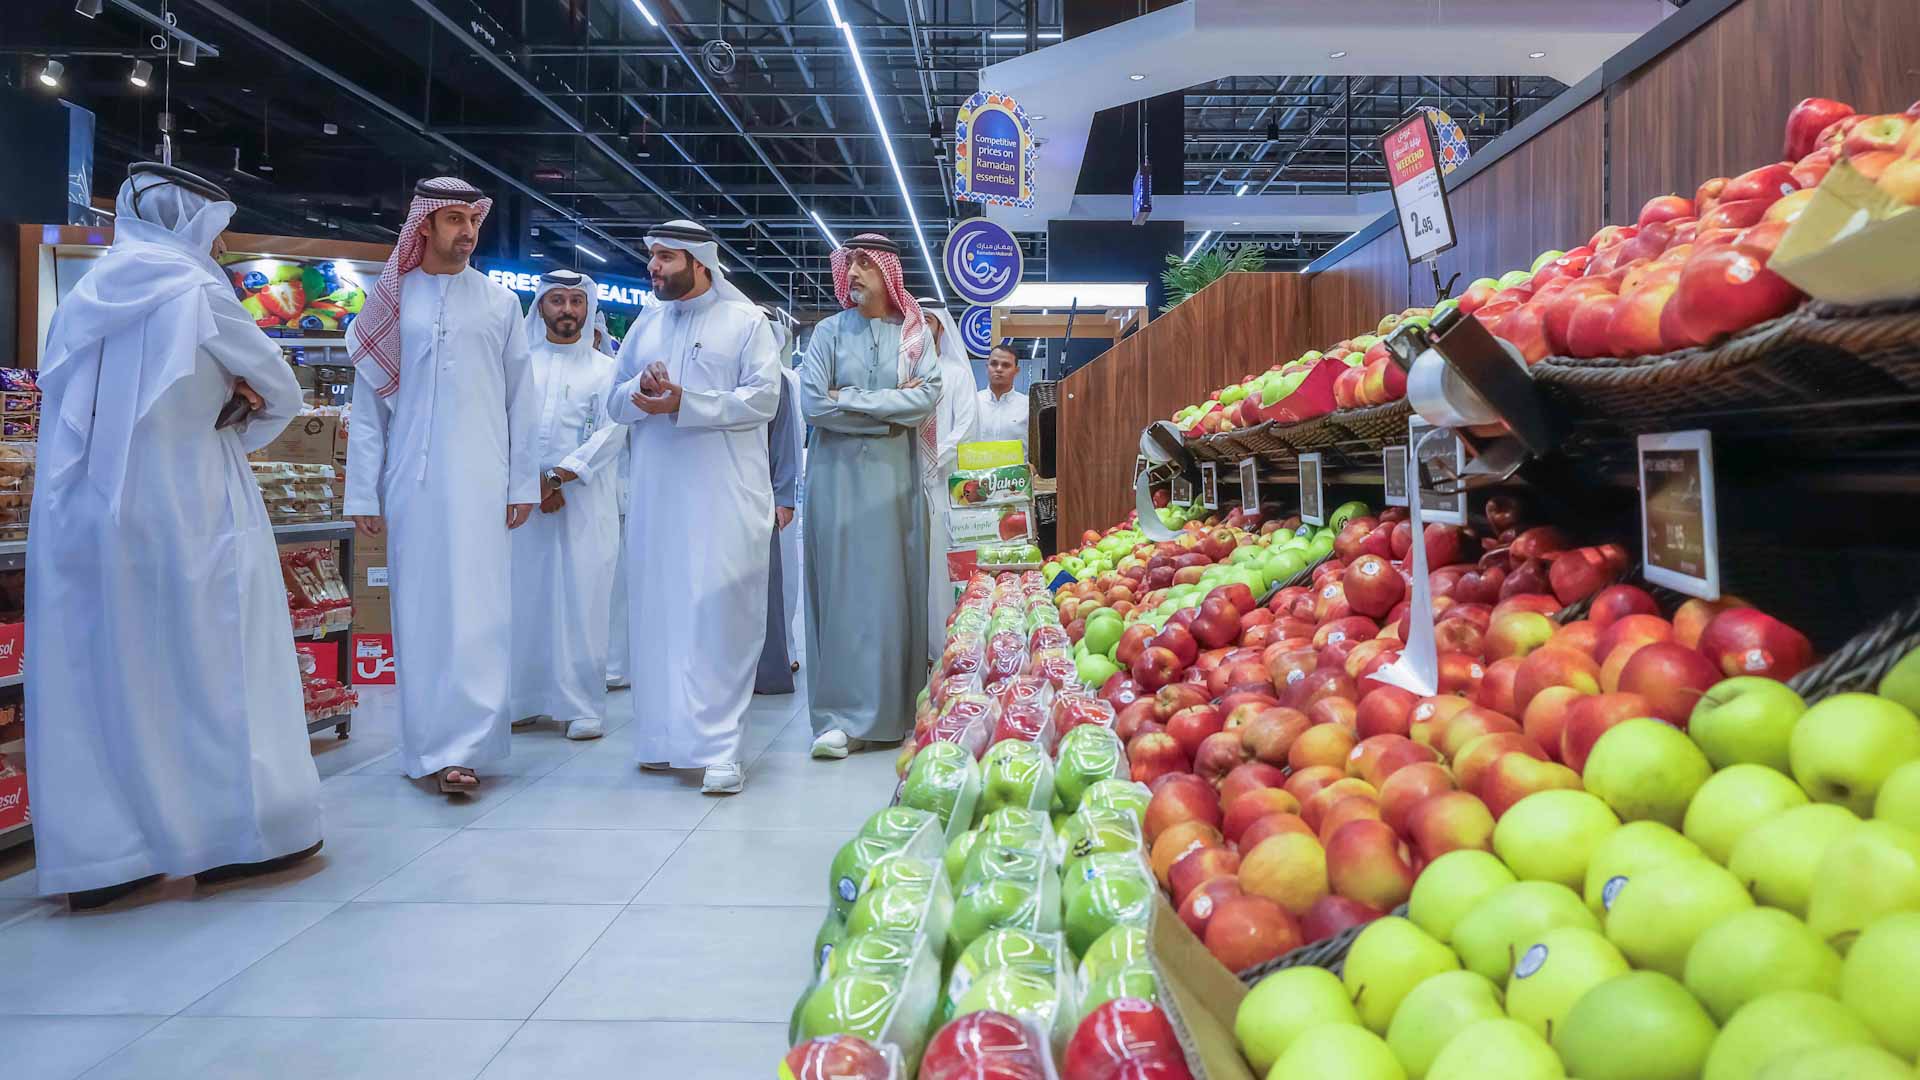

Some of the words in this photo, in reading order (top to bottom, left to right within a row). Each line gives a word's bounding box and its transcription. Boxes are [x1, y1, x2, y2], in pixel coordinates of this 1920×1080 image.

[975, 134, 1017, 148] Competitive
[978, 146, 1001, 157] prices
[1003, 149, 1014, 158] on
[976, 158, 1015, 172] Ramadan
[1395, 149, 1425, 172] WEEKEND
[975, 173, 1015, 185] essentials
[1410, 211, 1434, 238] 2.95
[0, 638, 14, 656] sol
